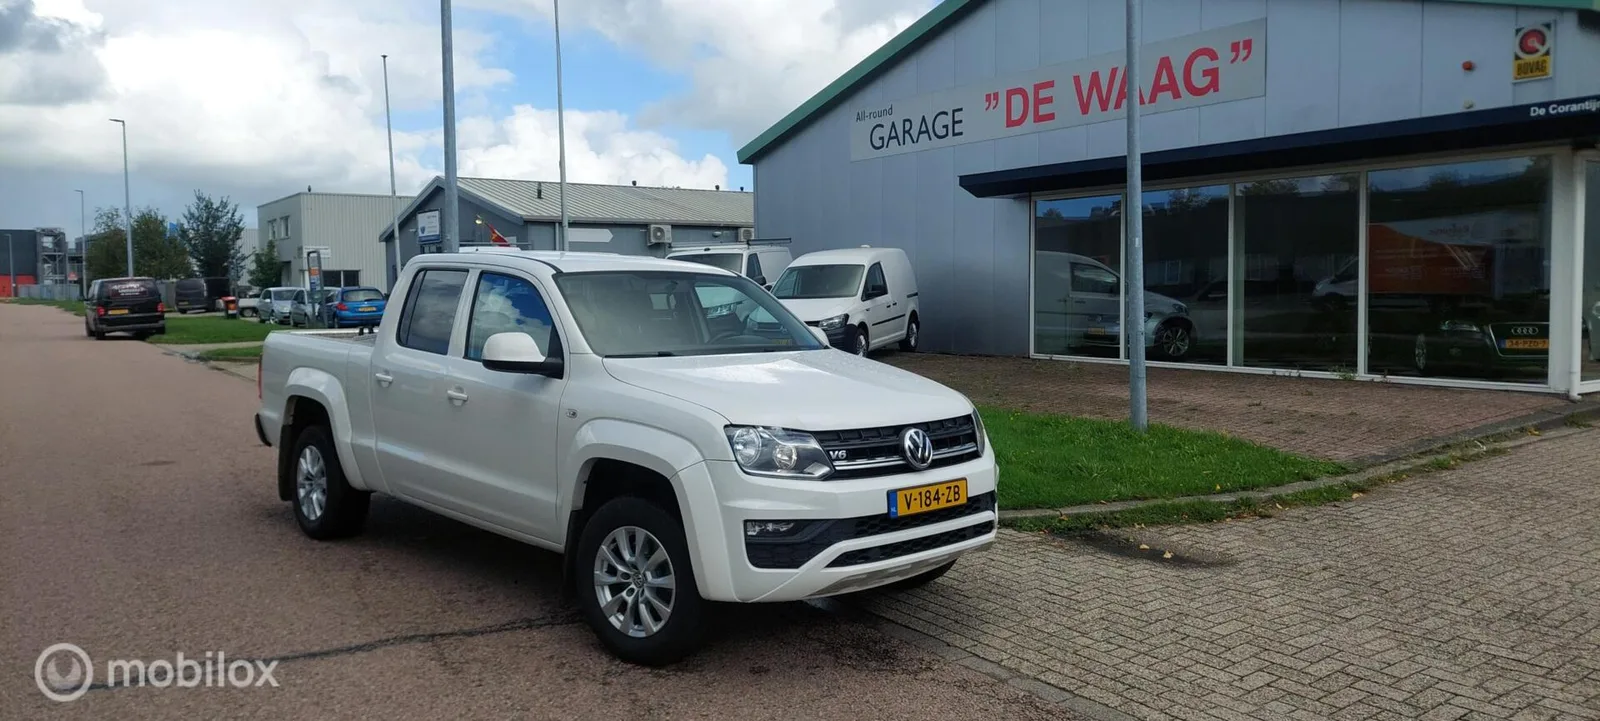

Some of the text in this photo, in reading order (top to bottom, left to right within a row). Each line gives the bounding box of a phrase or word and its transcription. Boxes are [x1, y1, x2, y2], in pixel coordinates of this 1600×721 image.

[1517, 60, 1546, 76] BOVAG
[856, 104, 893, 122] All-round
[1530, 106, 1546, 117] De
[869, 107, 963, 150] GARAGE
[829, 450, 847, 460] V6
[904, 485, 960, 510] V-184-ZB
